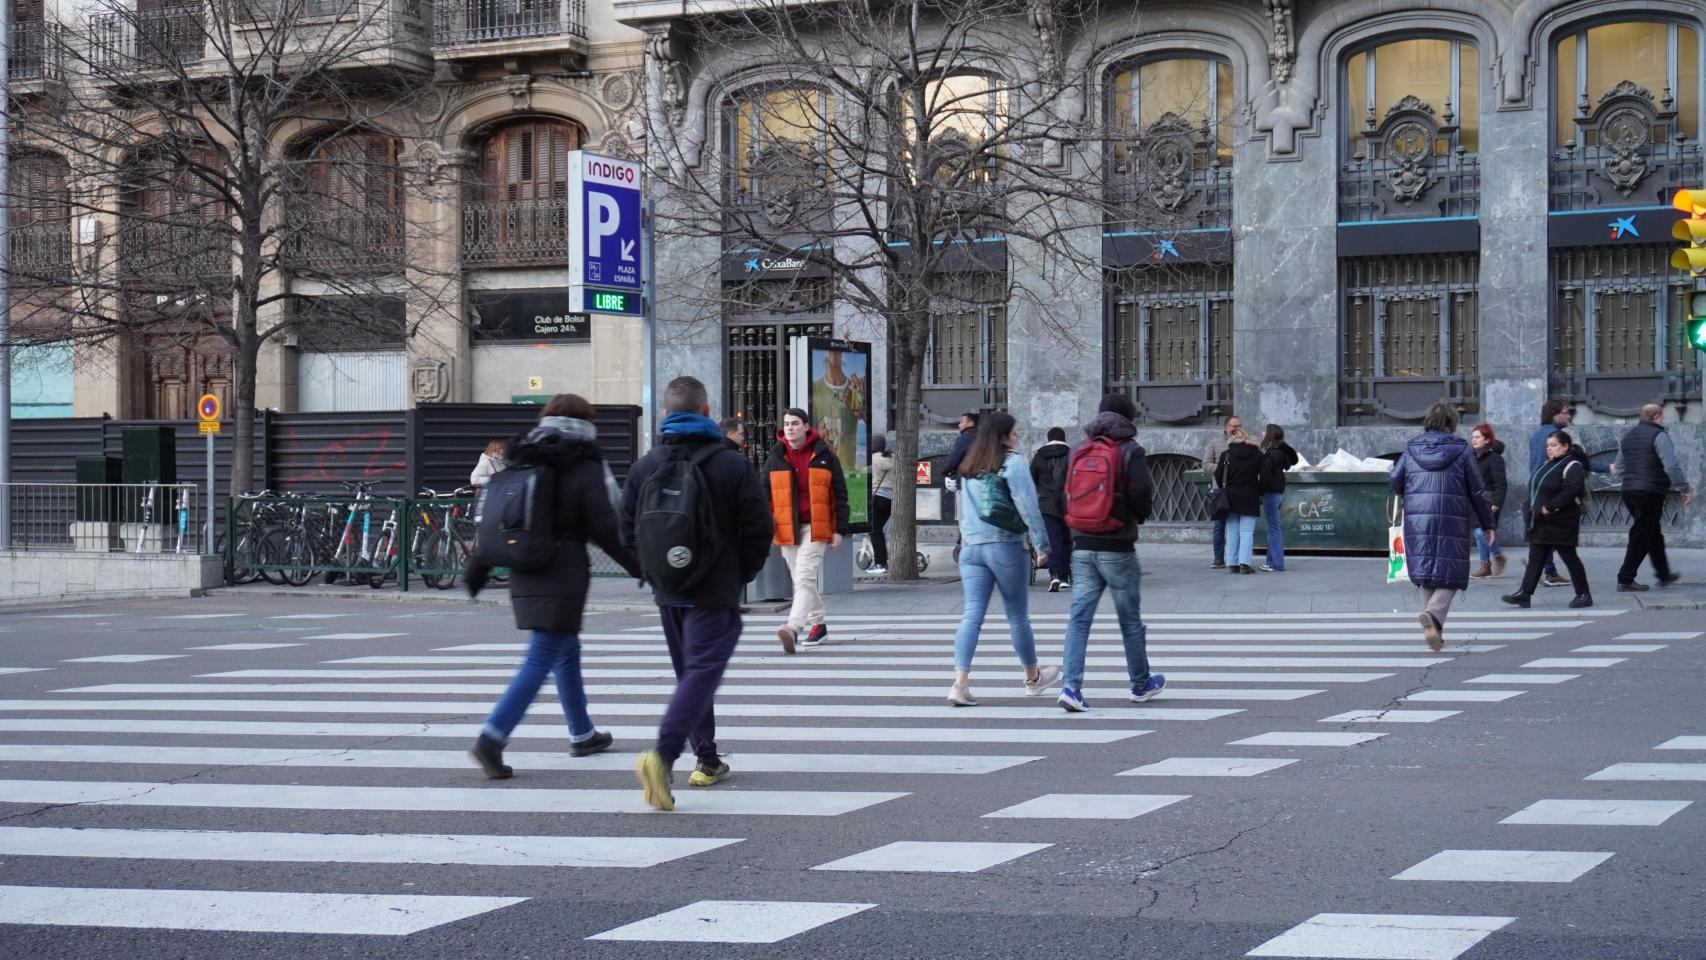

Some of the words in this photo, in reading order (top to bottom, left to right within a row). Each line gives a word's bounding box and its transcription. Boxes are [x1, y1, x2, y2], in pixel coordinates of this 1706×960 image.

[588, 161, 634, 184] INDIGO
[588, 190, 620, 258] P
[617, 265, 636, 275] PLAZA
[613, 274, 636, 284] ESPAÑA
[596, 293, 624, 311] LIBRE
[534, 315, 552, 324] Club
[553, 315, 563, 323] de
[564, 314, 585, 323] Bolsa
[534, 324, 558, 334] Cajero
